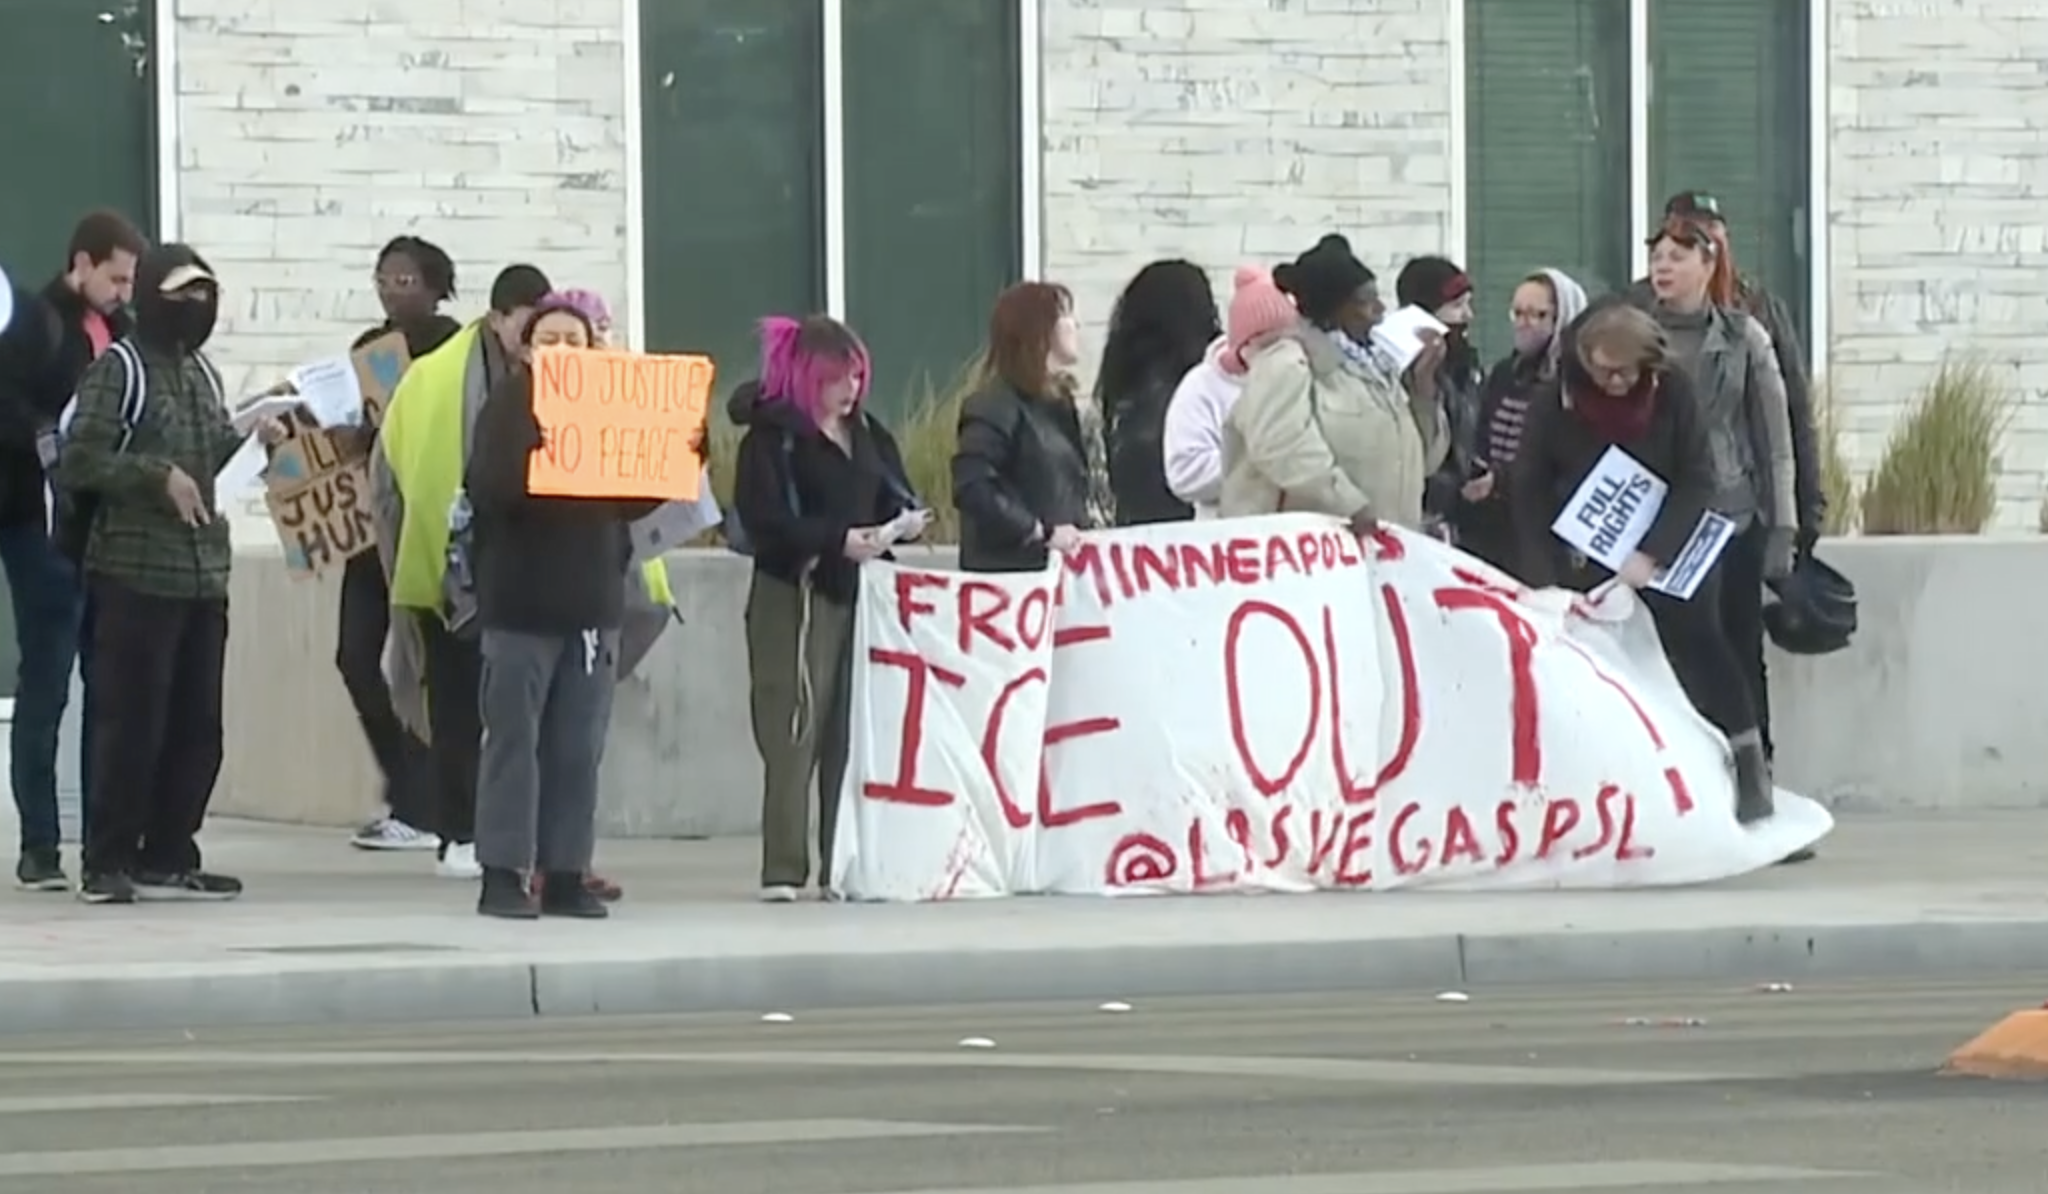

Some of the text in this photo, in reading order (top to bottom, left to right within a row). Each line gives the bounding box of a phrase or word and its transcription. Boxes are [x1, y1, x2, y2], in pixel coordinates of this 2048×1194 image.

[540, 353, 705, 412] NO JUSTICE
[535, 424, 679, 481] NO PEACE
[1576, 474, 1627, 530] FULL
[1589, 473, 1652, 556] RIGHTS
[894, 571, 1052, 654] FRO
[863, 625, 1121, 830] ICE
